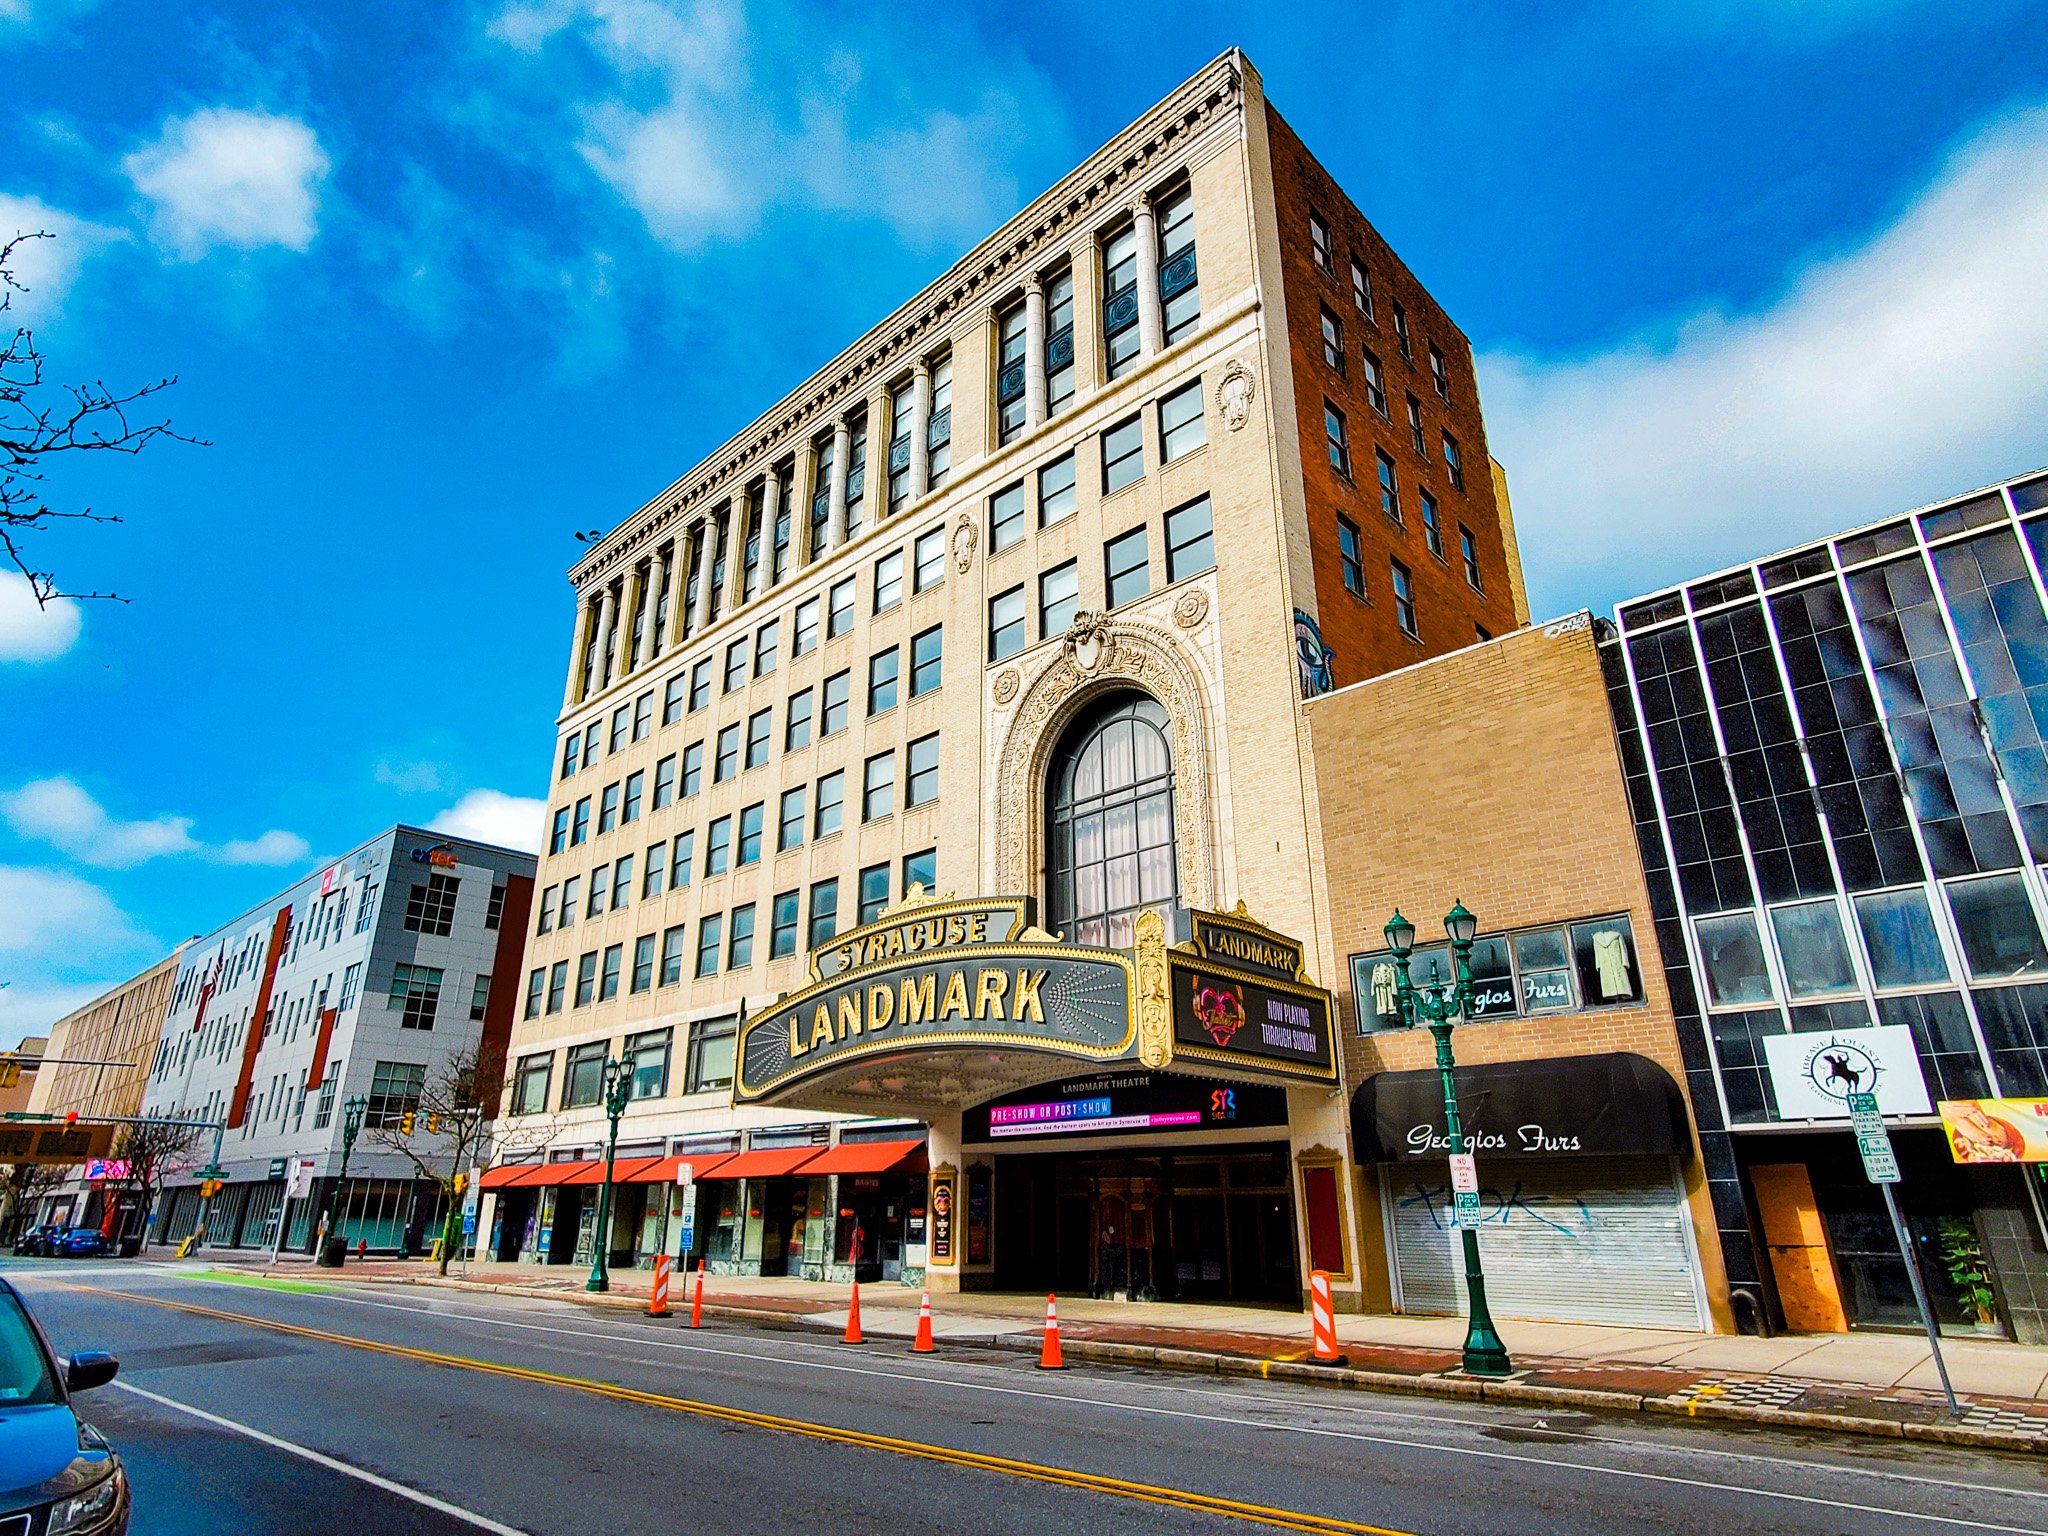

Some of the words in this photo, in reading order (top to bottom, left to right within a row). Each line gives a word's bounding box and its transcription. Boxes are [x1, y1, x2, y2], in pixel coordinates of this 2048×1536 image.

[836, 913, 988, 972] SYRACUSE
[1206, 929, 1294, 972] LANDMARK
[1523, 978, 1566, 1000] Furs
[790, 968, 1049, 1058] LANDMARK
[1267, 999, 1283, 1021] NOW
[1284, 1003, 1310, 1028] PLAYING
[1261, 1023, 1292, 1048] THROUGH
[1292, 1028, 1317, 1053] SUNDAY
[1803, 1040, 1827, 1070] BRAVE
[1843, 1038, 1881, 1063] QUEST
[1063, 1081, 1109, 1093] LANDMARK
[1111, 1076, 1150, 1089] THEATRE
[991, 1108, 1035, 1122] PRE-SHOW
[1040, 1106, 1051, 1118] OR
[1055, 1101, 1108, 1116] POST-SHOW
[1407, 1124, 1507, 1154] Geogios
[1517, 1124, 1581, 1151] Furs
[1861, 1140, 1869, 1154] 2
